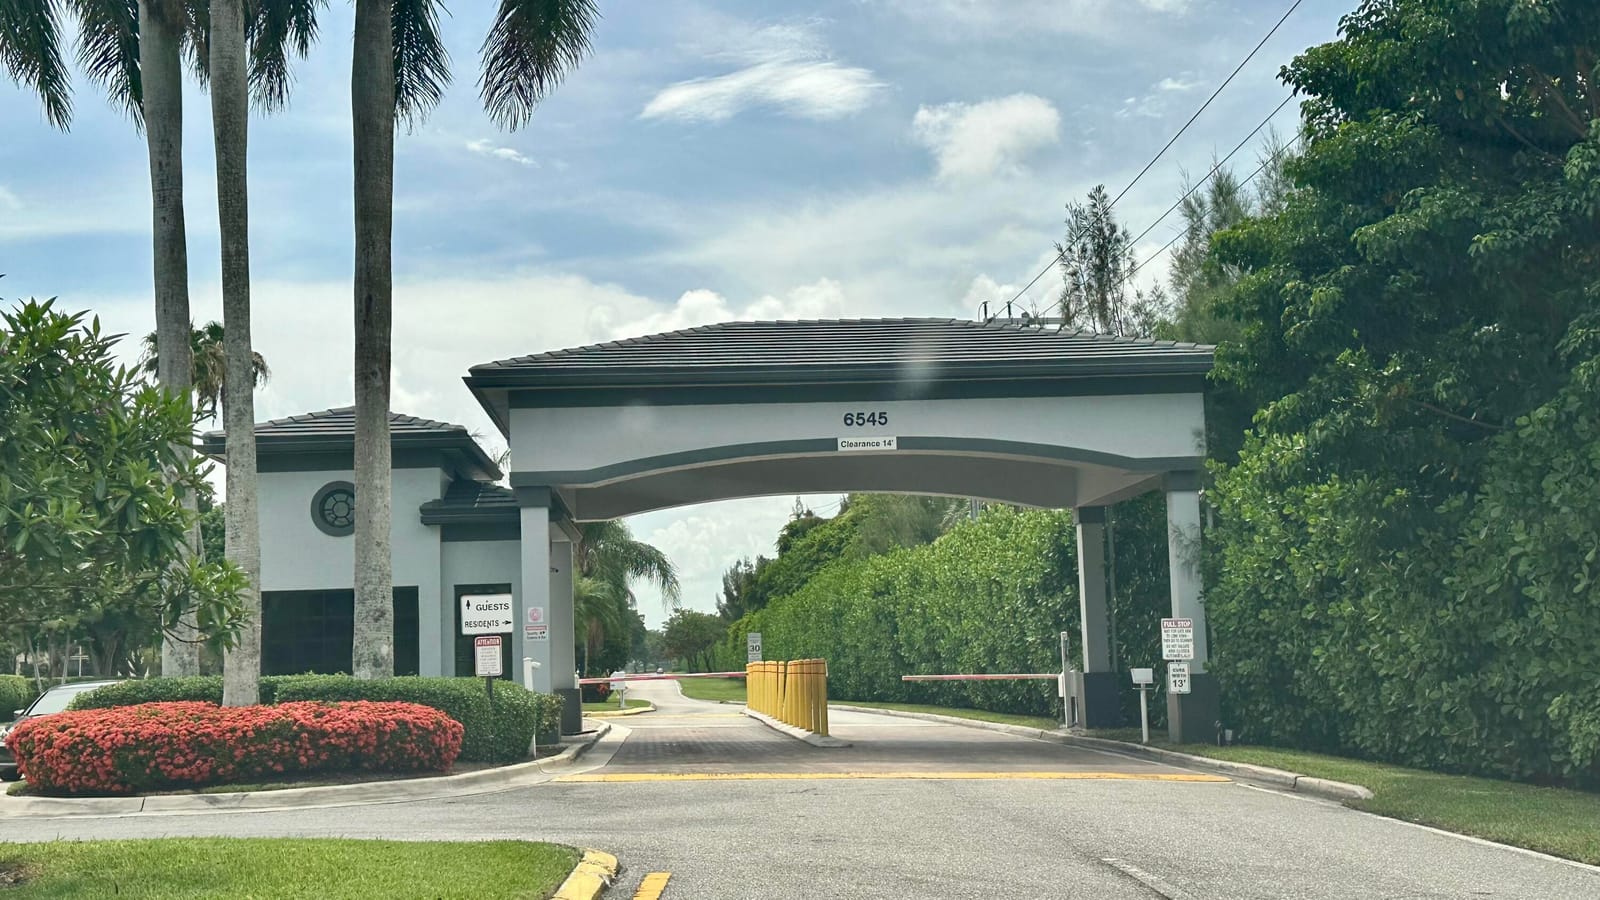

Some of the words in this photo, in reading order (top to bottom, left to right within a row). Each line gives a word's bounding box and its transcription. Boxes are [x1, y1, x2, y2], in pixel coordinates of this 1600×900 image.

[843, 411, 888, 427] 6545
[840, 440, 881, 448] Clearance
[475, 602, 510, 611] GUESTS
[464, 619, 499, 628] RESIDENTS
[1177, 620, 1191, 628] STOP
[749, 644, 761, 652] 30
